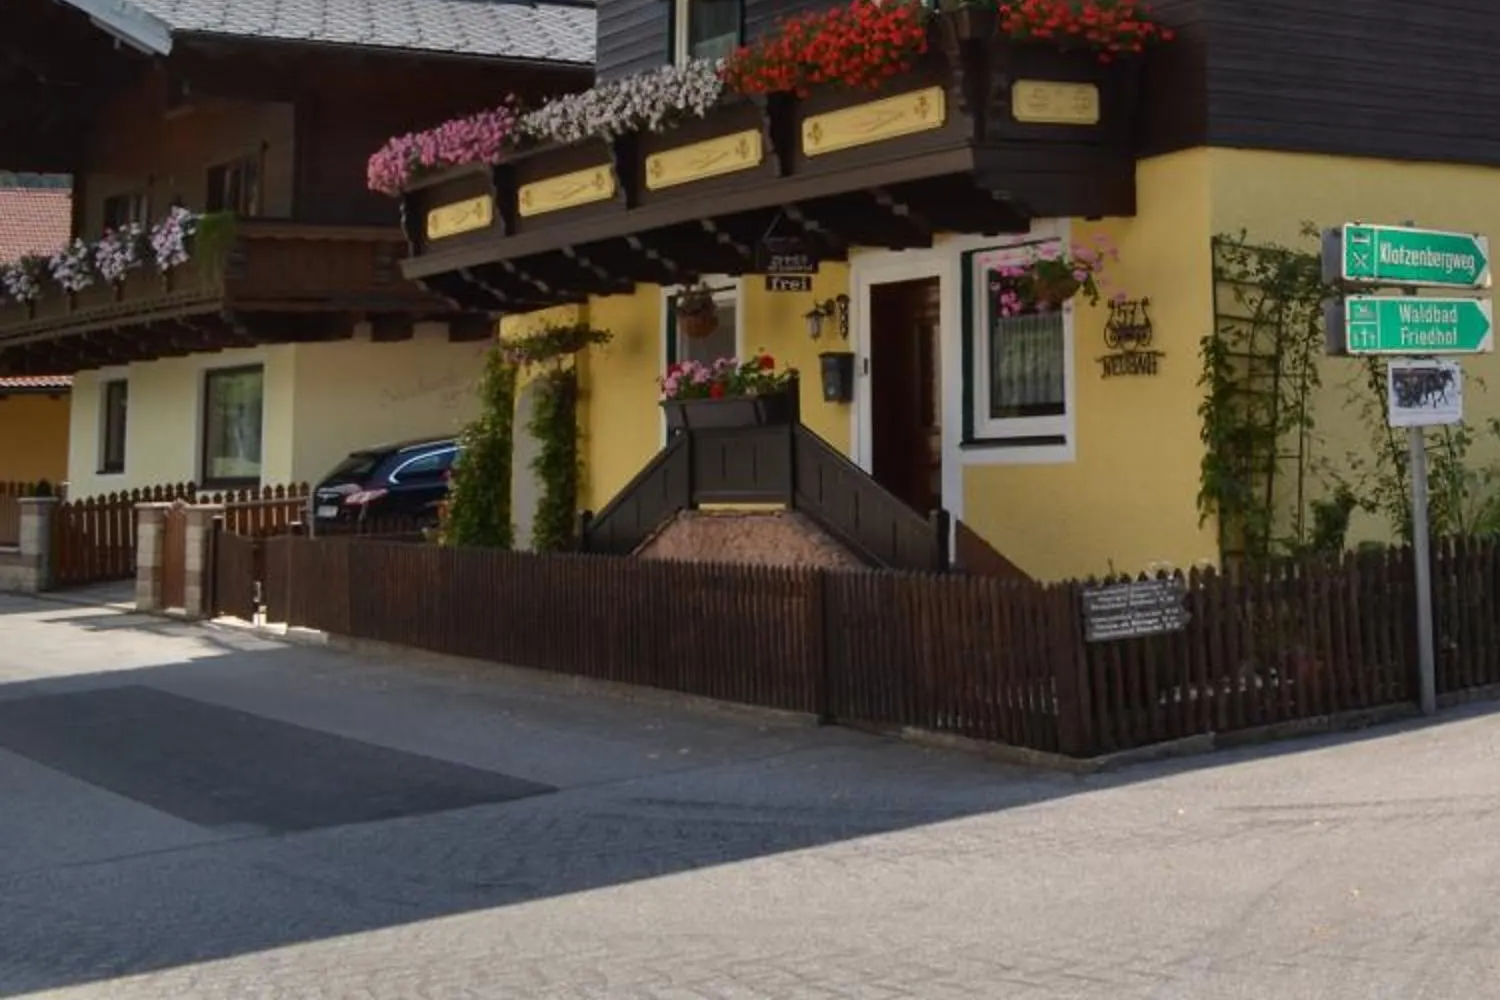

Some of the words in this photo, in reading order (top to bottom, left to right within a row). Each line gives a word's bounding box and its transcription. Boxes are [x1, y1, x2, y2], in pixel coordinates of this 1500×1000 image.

[1379, 242, 1475, 274] Klotzenbergweg
[1399, 303, 1458, 325] Waldbad
[1400, 326, 1458, 346] Friedhof
